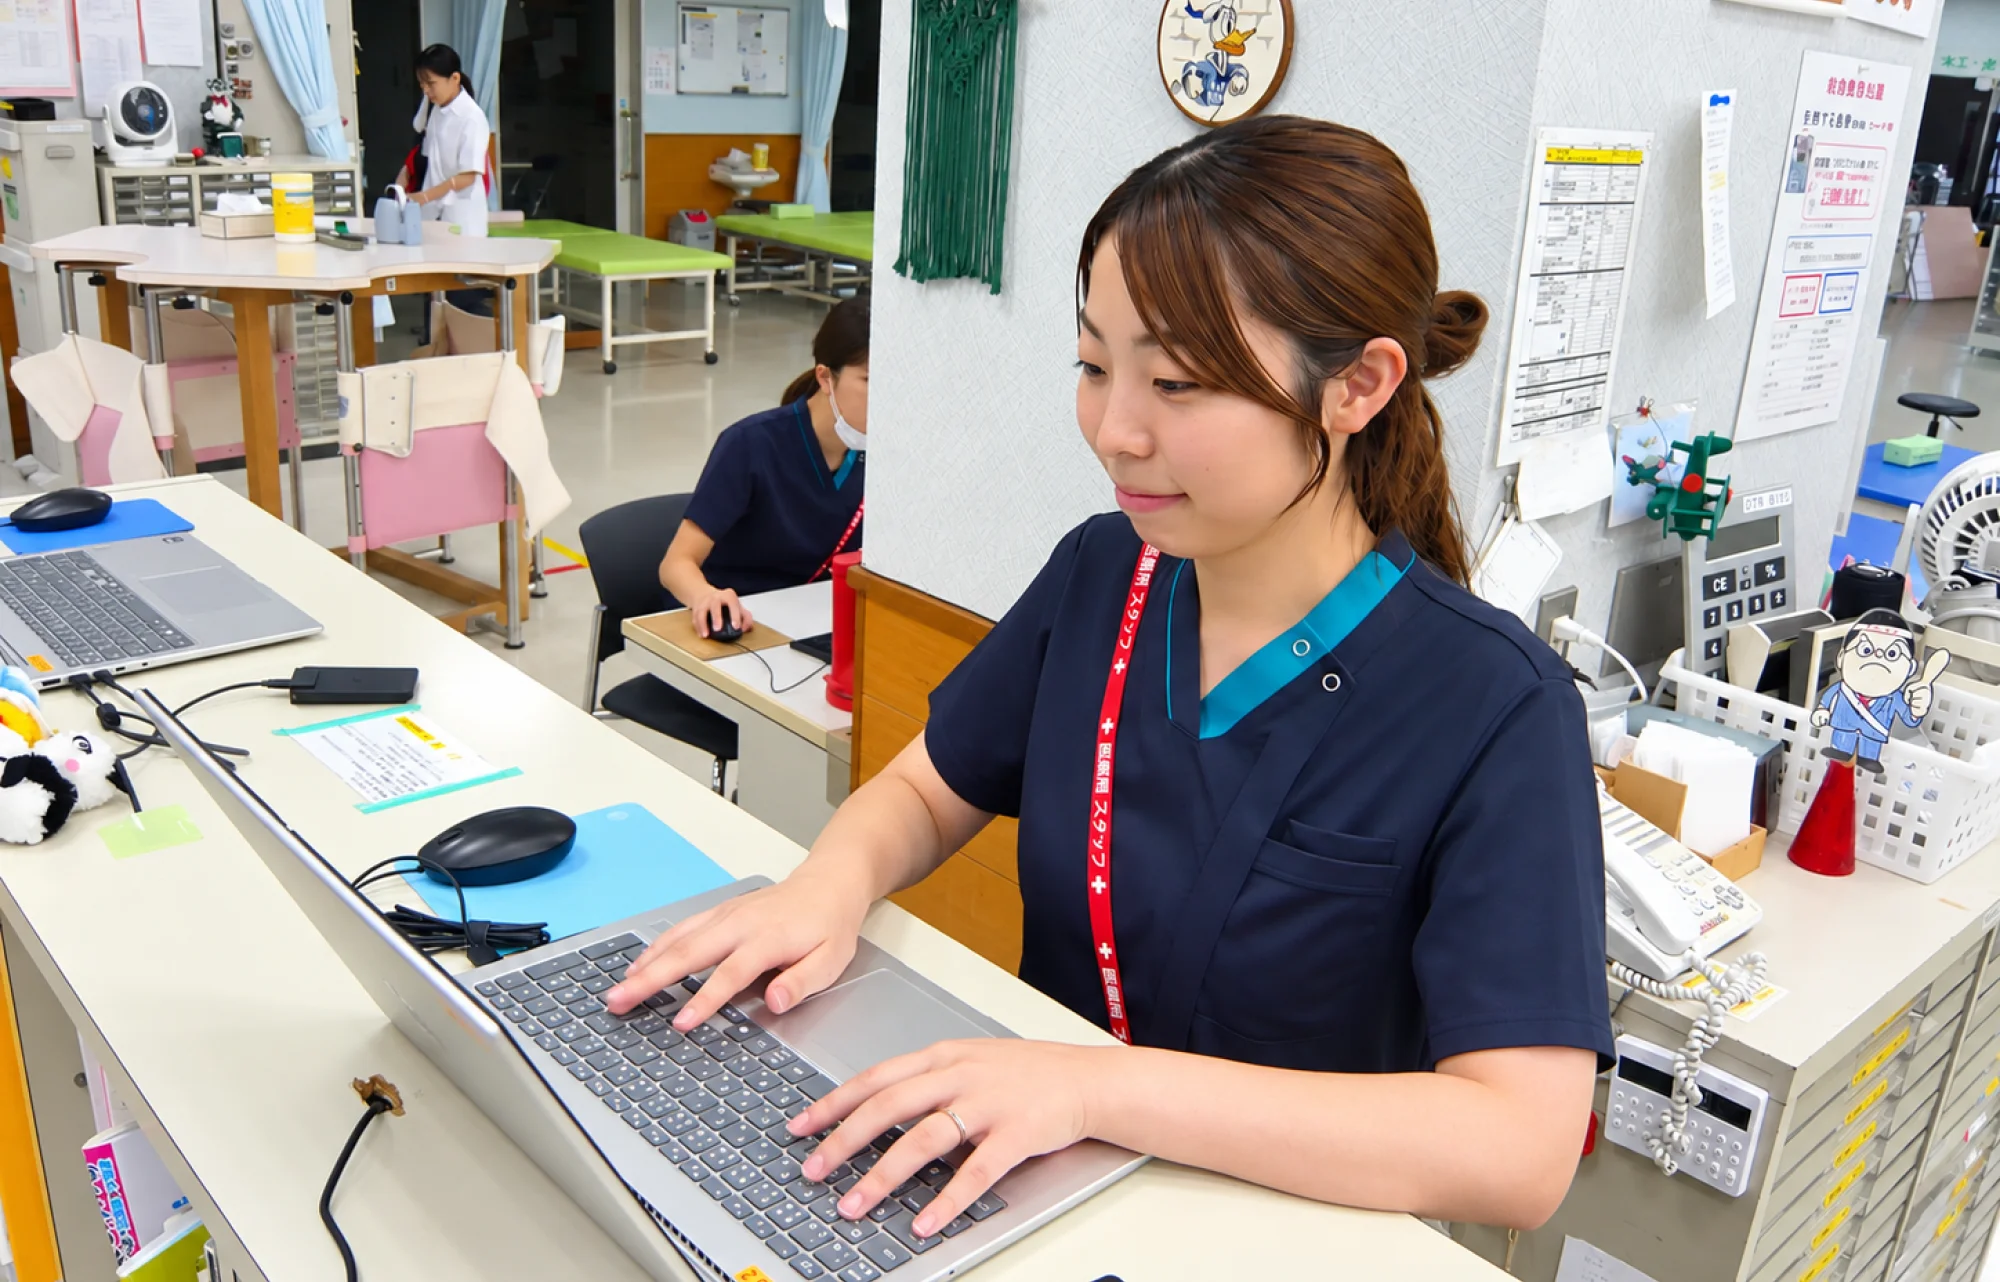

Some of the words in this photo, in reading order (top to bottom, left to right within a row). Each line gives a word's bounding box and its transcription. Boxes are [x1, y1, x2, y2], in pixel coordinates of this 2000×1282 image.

[1713, 576, 1728, 593] CE
[1091, 799, 1109, 868] スタッフ
